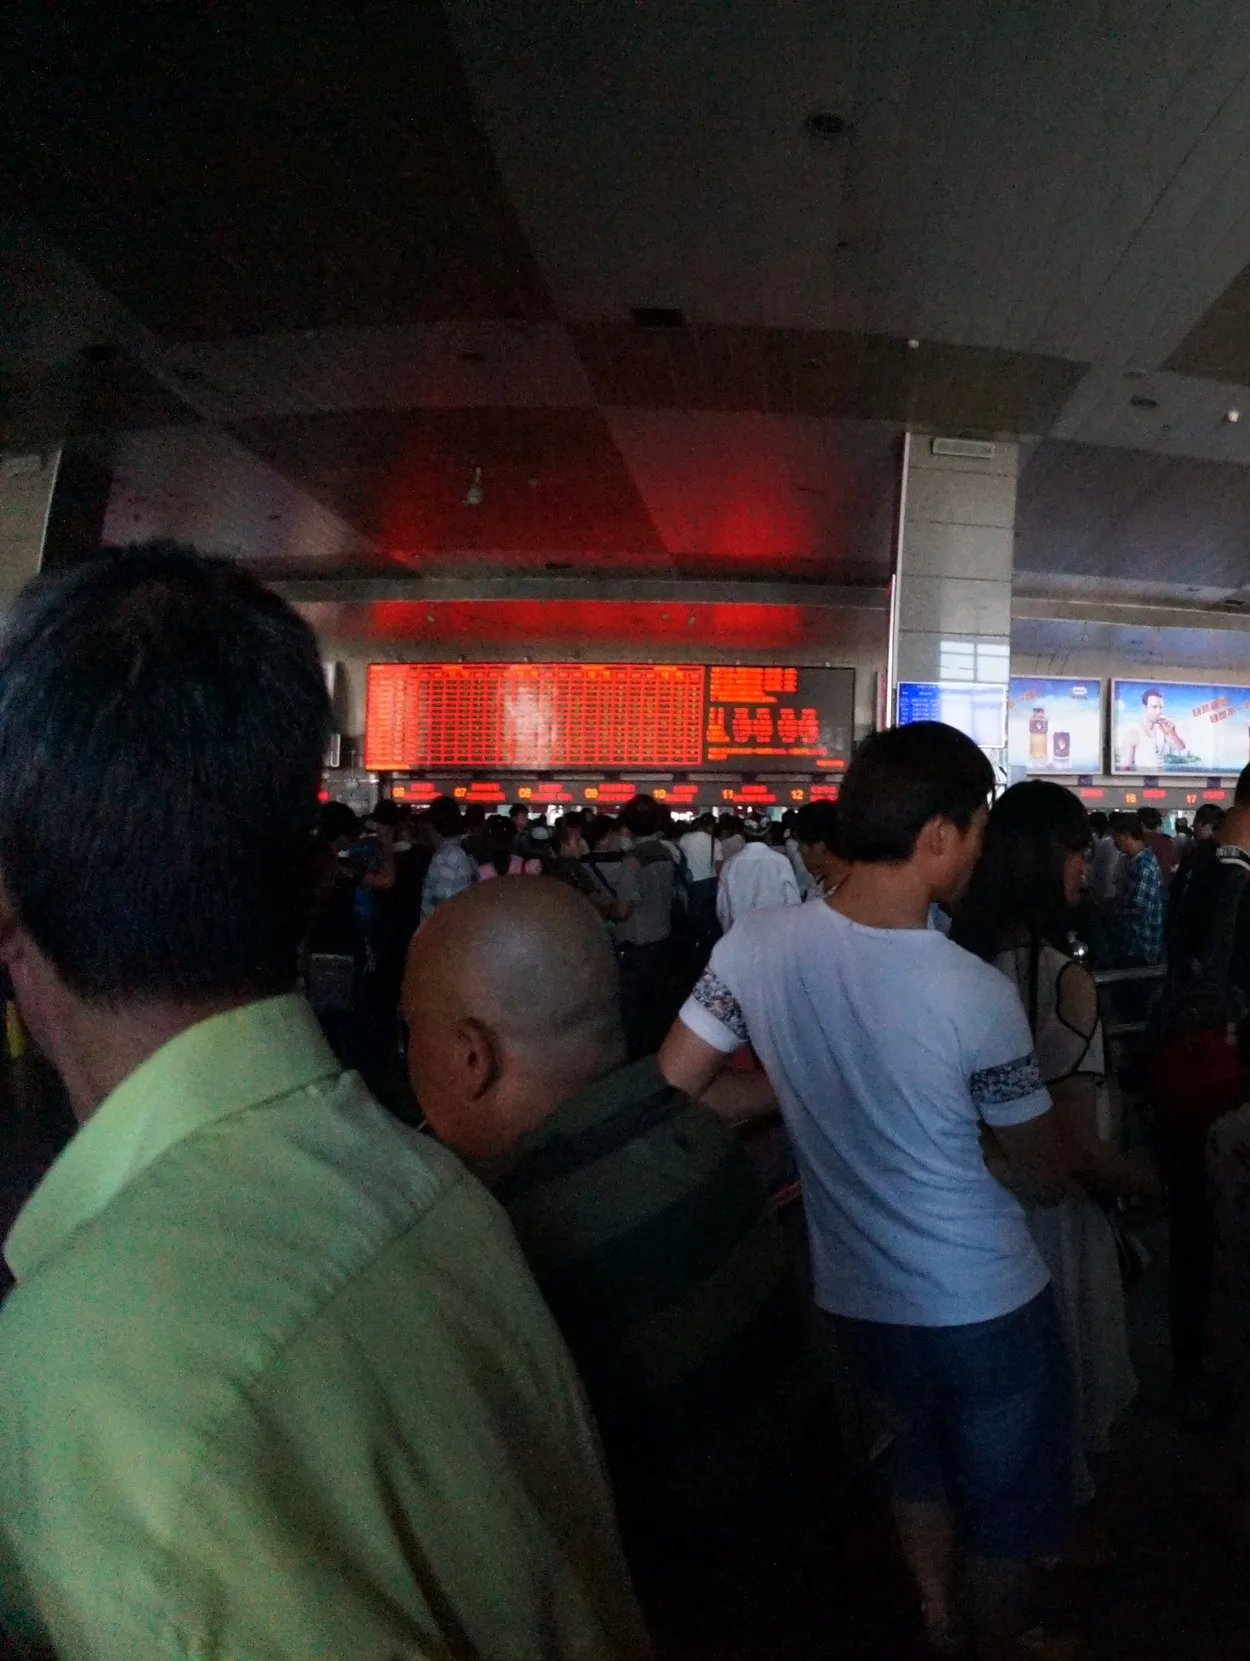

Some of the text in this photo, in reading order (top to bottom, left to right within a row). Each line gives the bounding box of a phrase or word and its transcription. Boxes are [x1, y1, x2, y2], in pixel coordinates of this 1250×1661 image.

[455, 787, 467, 798] 07
[653, 789, 666, 799] 10
[722, 789, 734, 800] 11
[791, 790, 804, 799] 12
[1186, 794, 1197, 803] 17
